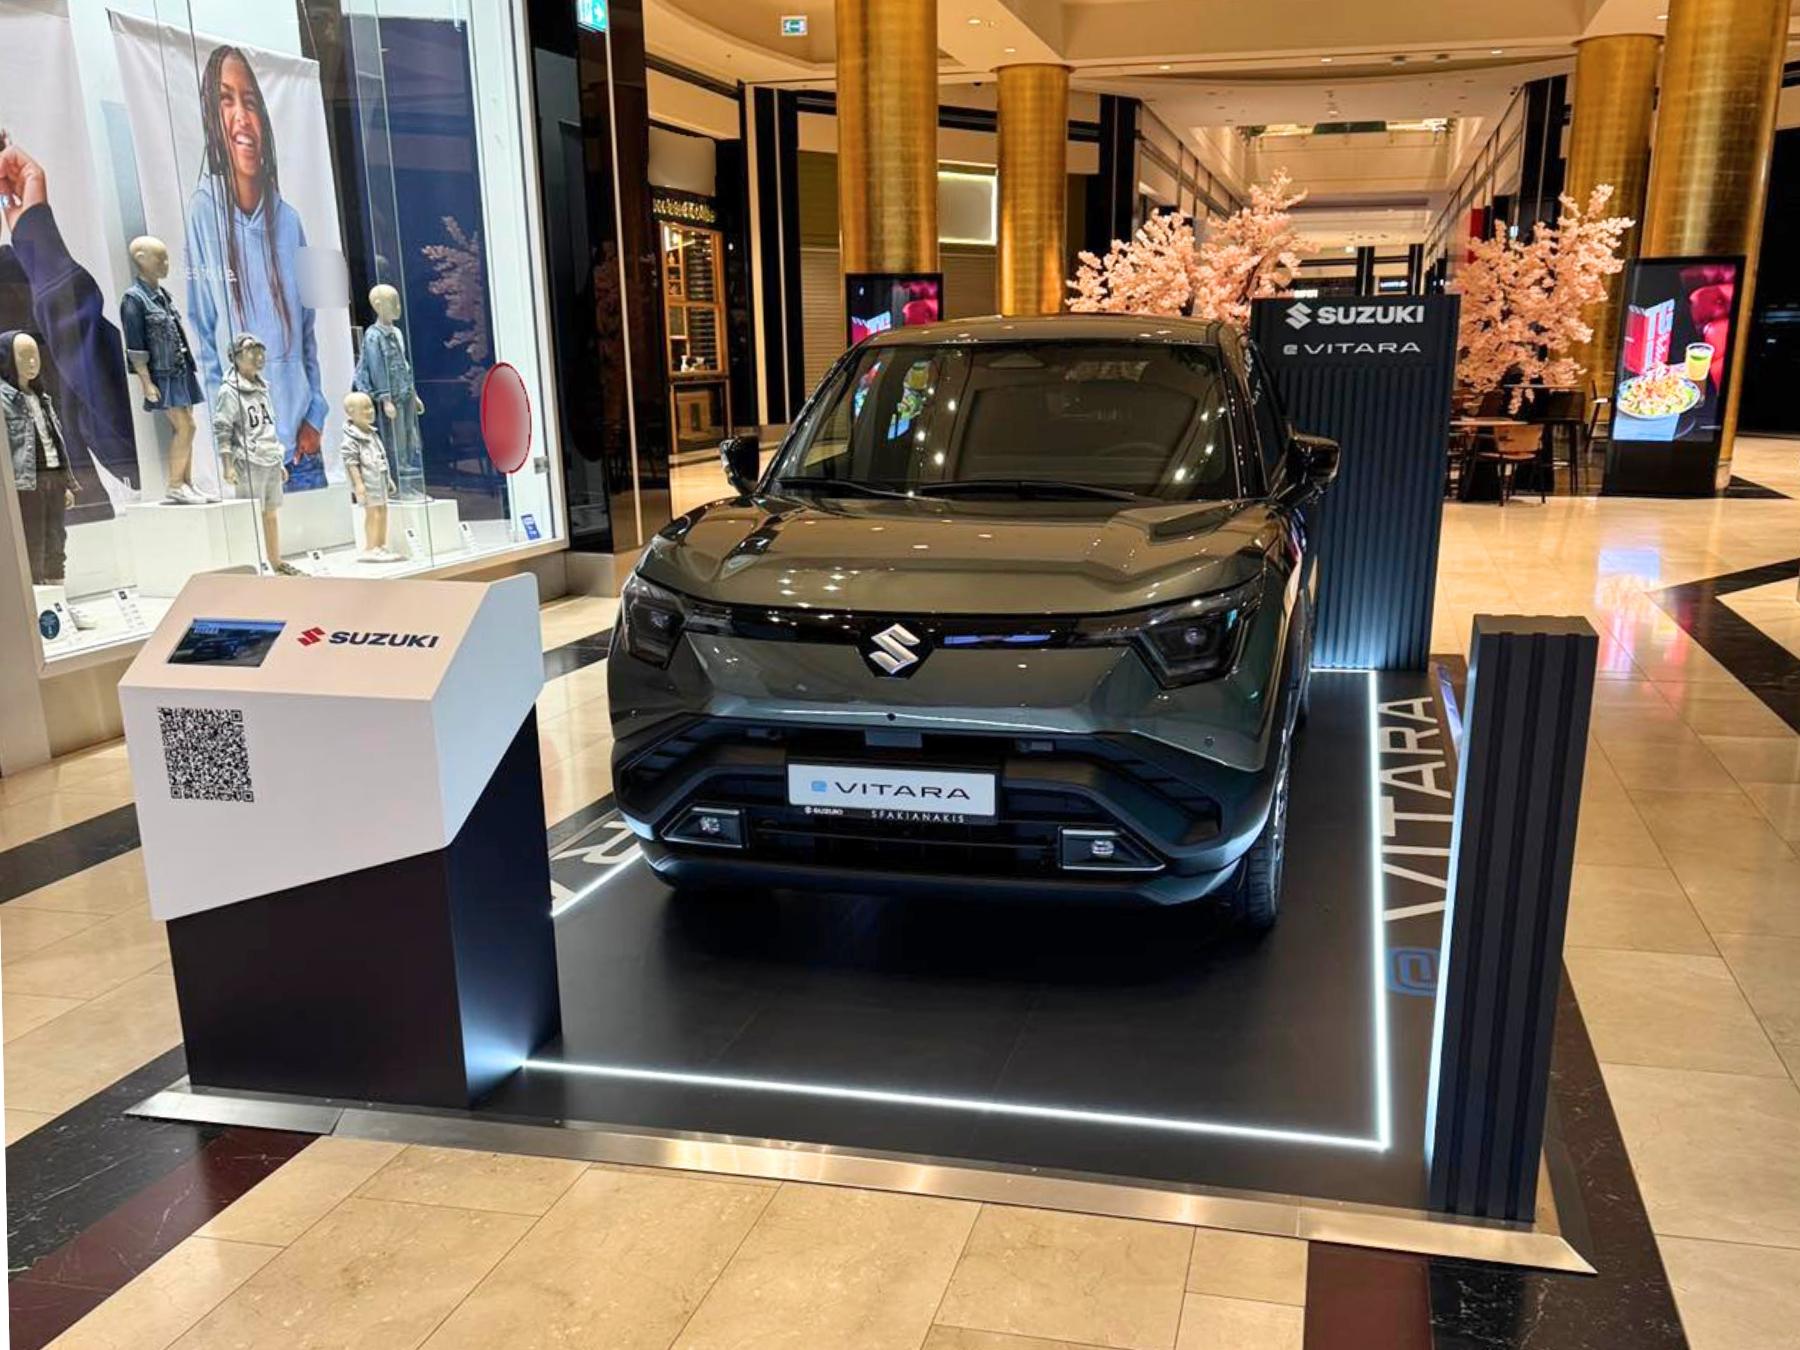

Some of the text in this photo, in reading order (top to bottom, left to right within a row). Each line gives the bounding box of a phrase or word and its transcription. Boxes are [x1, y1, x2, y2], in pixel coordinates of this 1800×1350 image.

[1317, 305, 1425, 325] SUZUKI
[1304, 342, 1421, 354] VITARA
[247, 403, 273, 428] GA
[328, 631, 439, 648] SUZUKI
[834, 782, 971, 800] VITARA
[871, 810, 965, 824] SFAKIANAKIS
[1379, 696, 1455, 921] VITARA
